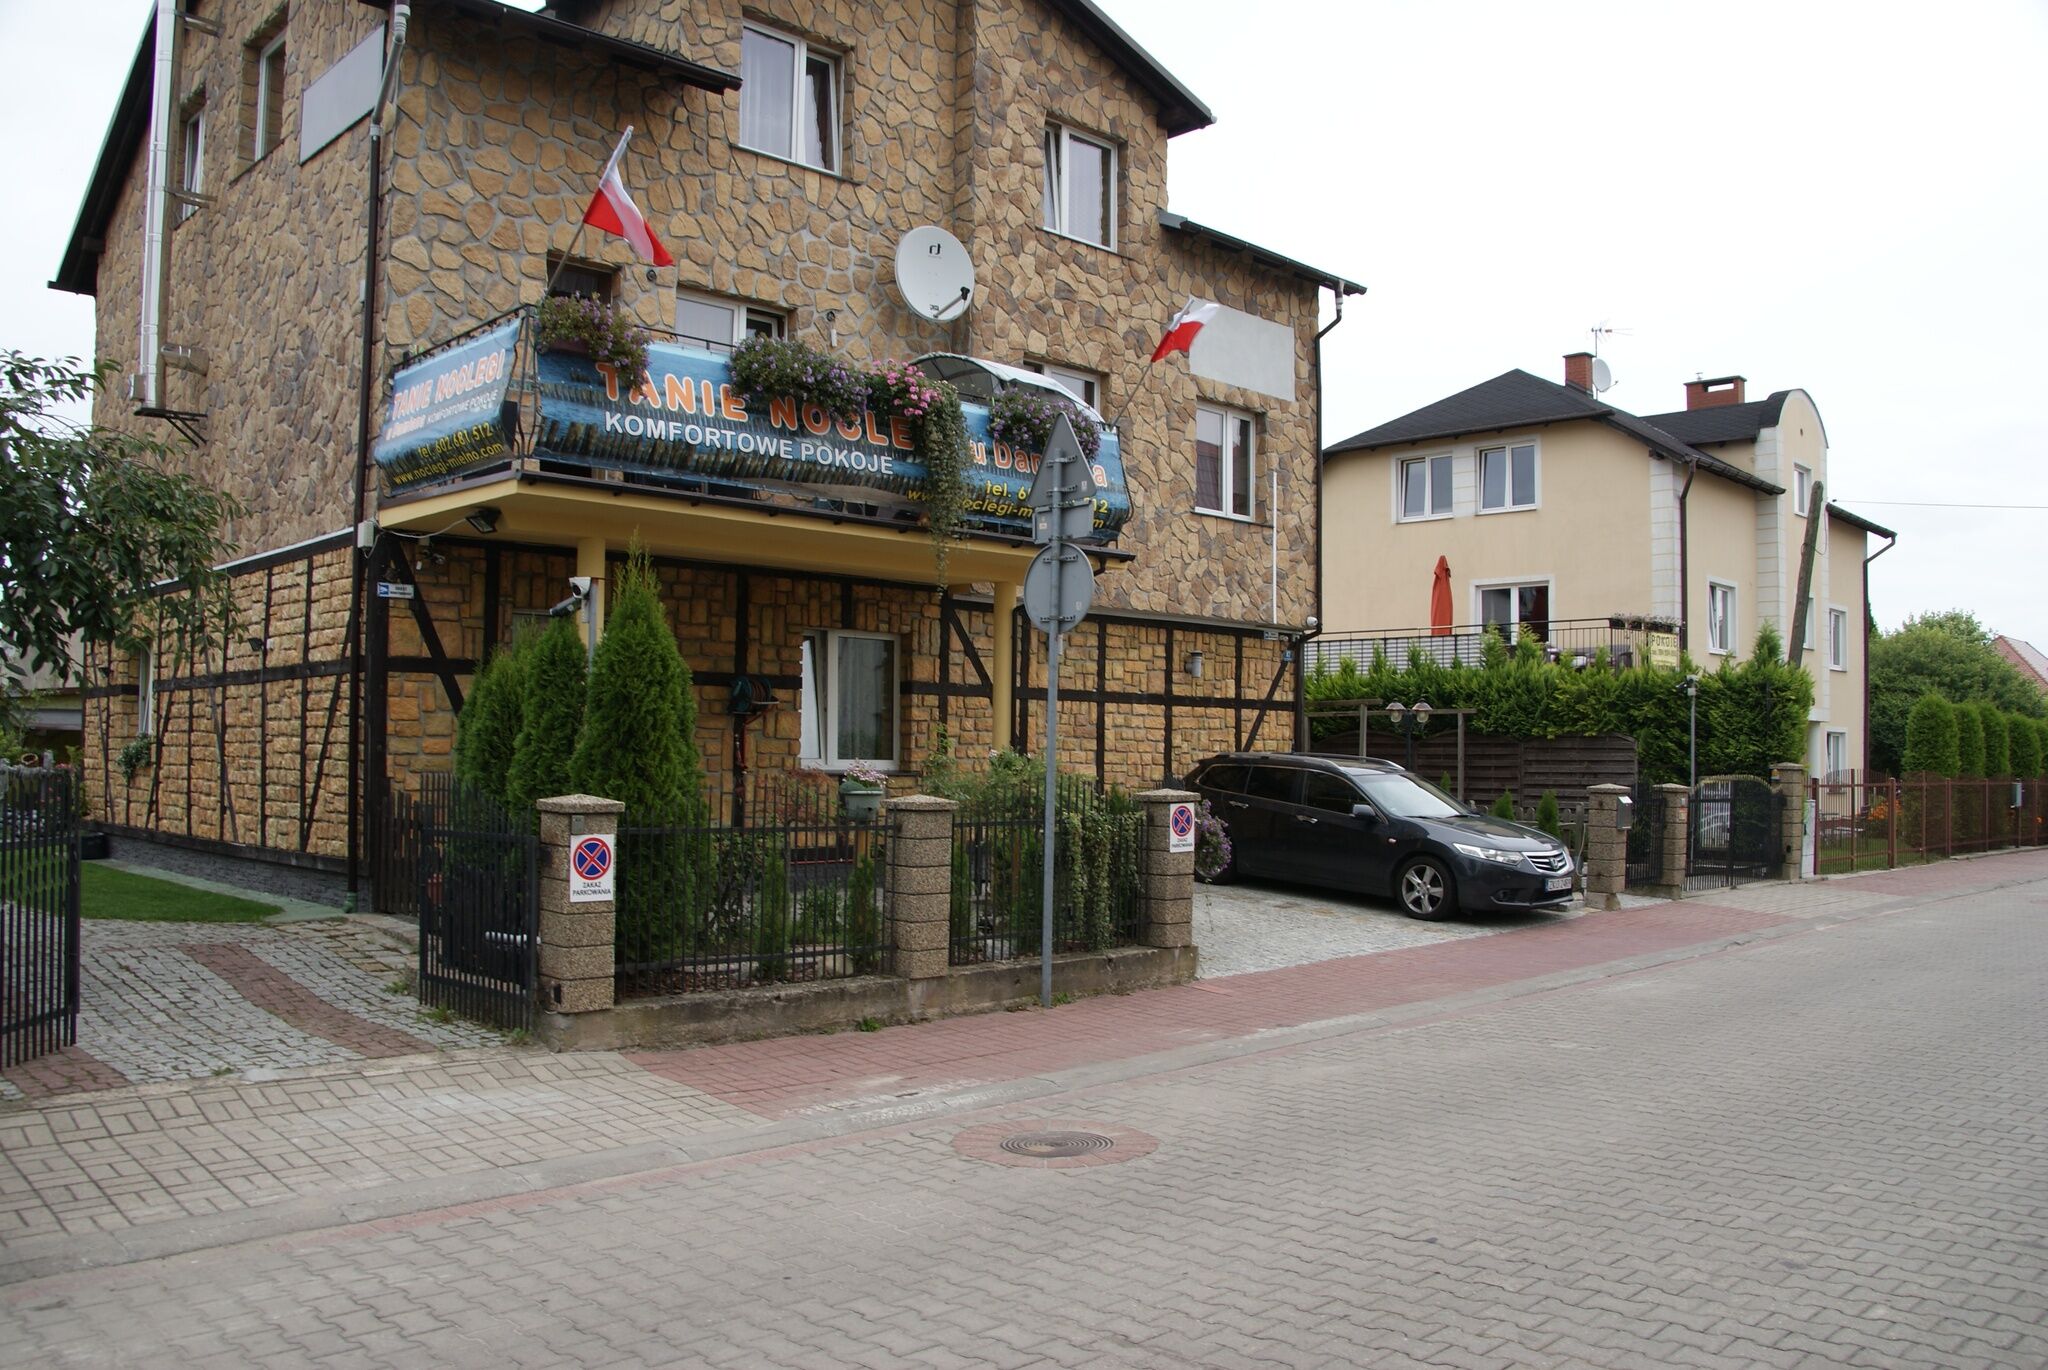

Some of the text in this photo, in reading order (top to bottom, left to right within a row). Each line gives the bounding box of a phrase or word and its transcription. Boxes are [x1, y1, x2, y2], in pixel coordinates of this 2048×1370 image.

[392, 348, 506, 421] TANIE NOCLEGI
[595, 362, 916, 450] TANIE NOCLE
[605, 410, 894, 475] KOMFORTOWE POKOJE
[986, 480, 1012, 498] tel.
